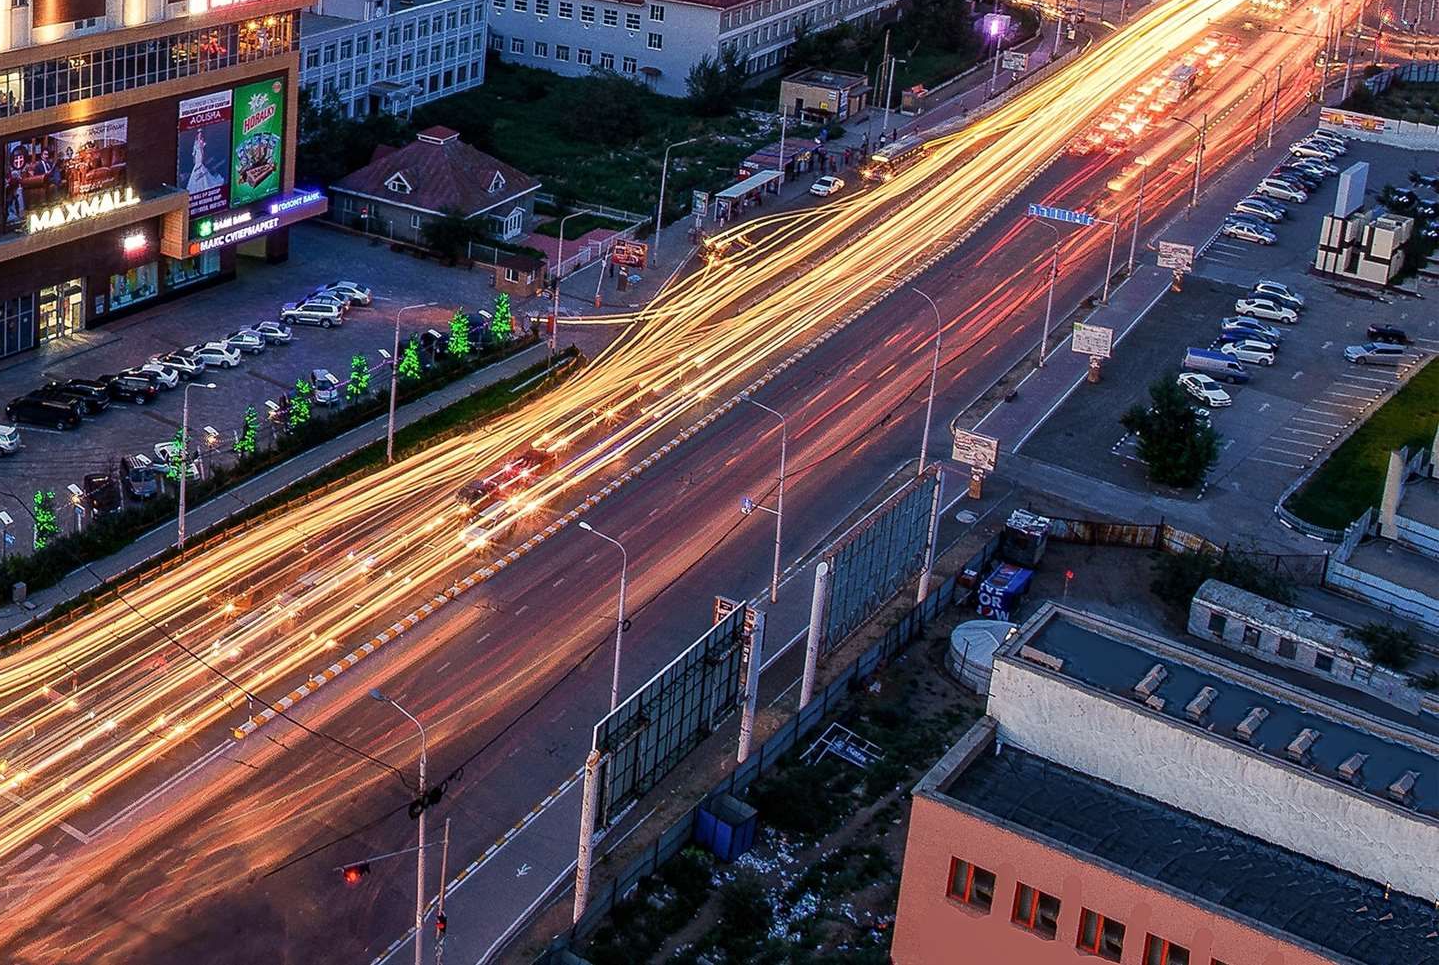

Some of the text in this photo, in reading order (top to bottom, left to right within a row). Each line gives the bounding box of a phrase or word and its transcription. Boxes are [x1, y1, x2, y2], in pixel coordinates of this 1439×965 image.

[30, 186, 141, 235] MAXMALL
[200, 217, 280, 252] МАКС СУПЕРМАРКЕТ
